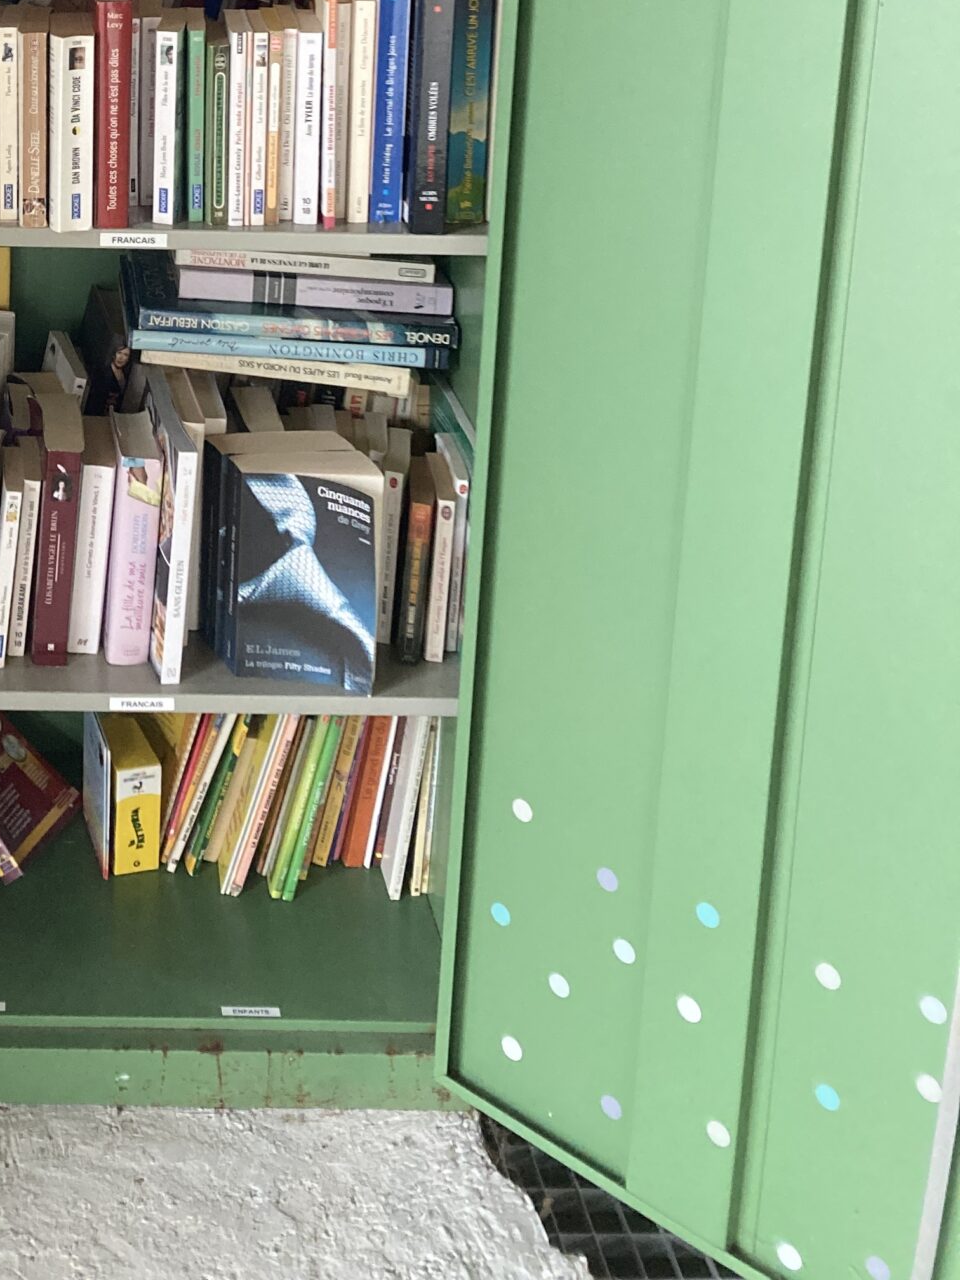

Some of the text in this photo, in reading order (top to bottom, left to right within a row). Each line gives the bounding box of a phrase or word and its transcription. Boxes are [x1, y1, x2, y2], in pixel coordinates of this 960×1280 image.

[72, 76, 81, 92] CODE
[428, 81, 439, 141] OMBRES VOLÉES
[107, 48, 121, 211] Toutes ces choses qu'on ne s'est pas dites
[72, 147, 80, 184] DAN BROWN
[200, 318, 249, 332] GASTON
[268, 344, 419, 363] CHRIS BONINGTON
[317, 485, 371, 513] Cinquante
[327, 500, 371, 523] nuances
